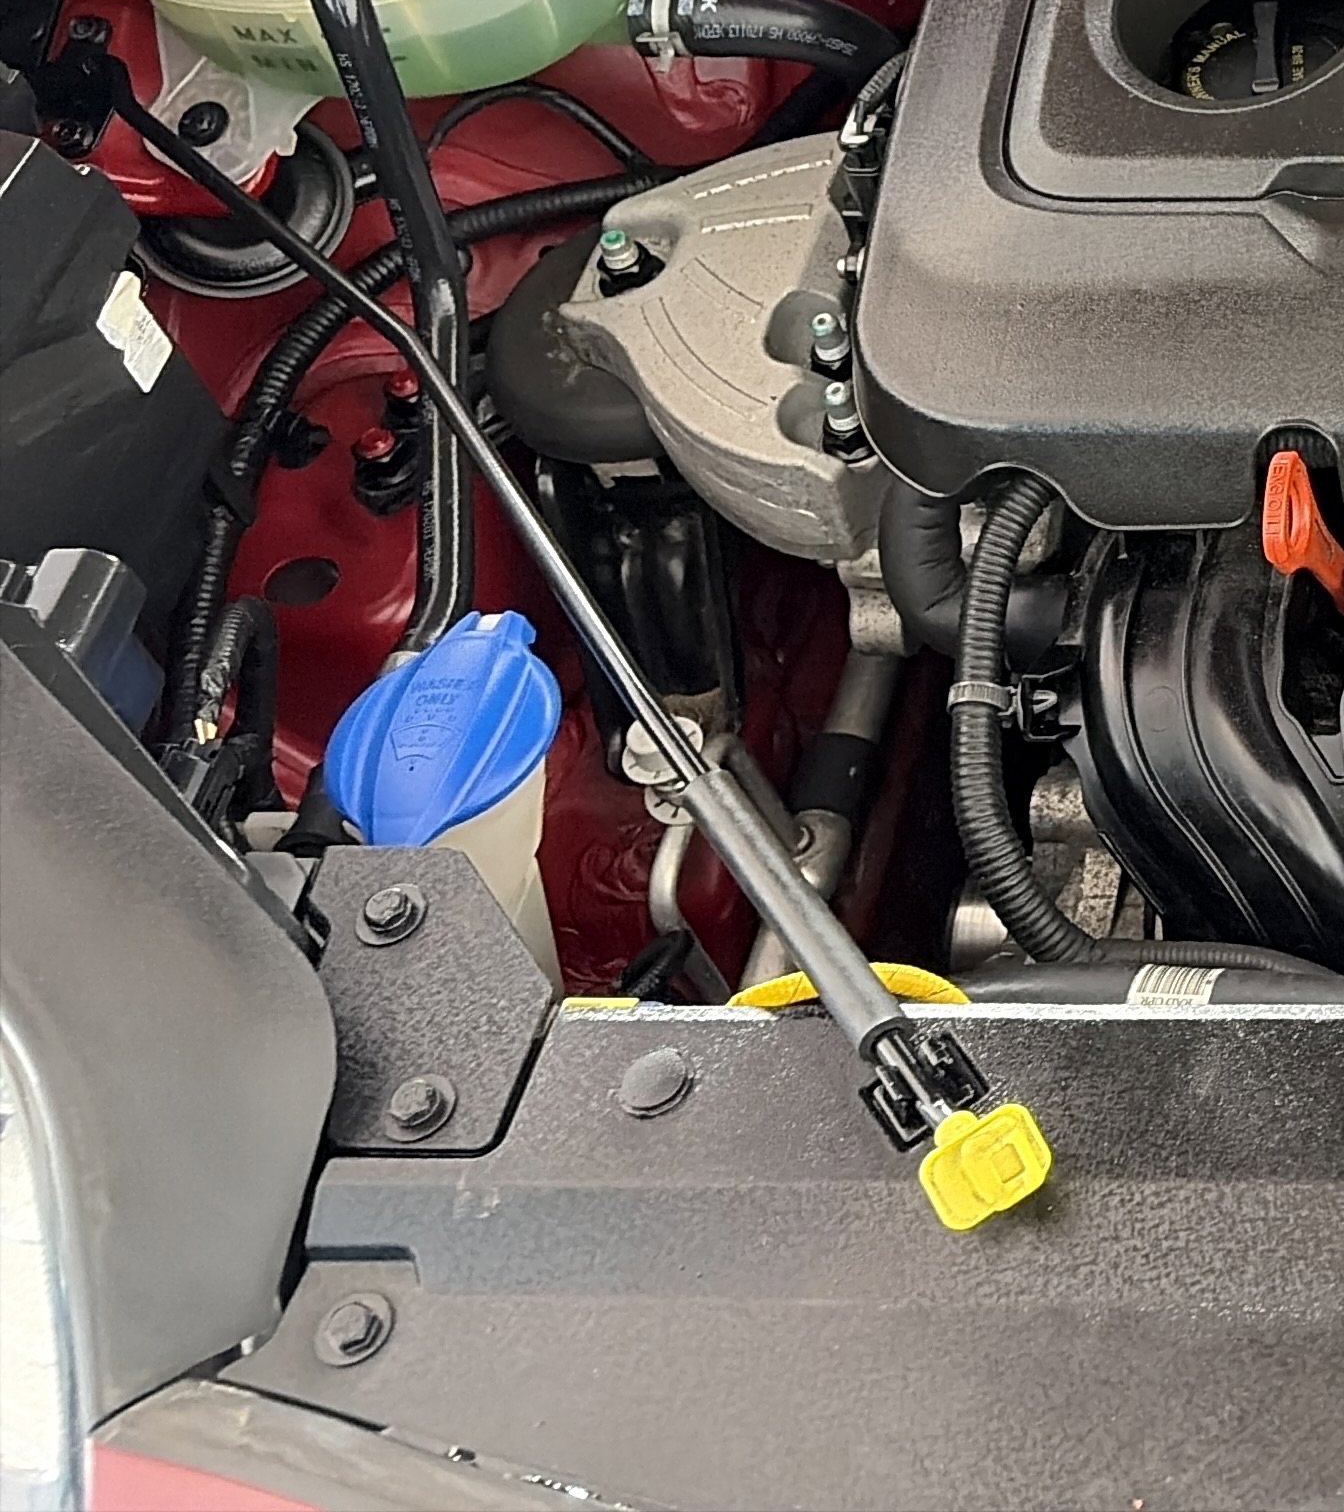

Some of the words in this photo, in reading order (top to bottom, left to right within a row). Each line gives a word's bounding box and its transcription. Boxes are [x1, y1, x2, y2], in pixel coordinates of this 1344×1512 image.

[232, 25, 298, 44] MAX
[1192, 30, 1247, 64] MANUAL
[251, 54, 319, 73] MIN
[1267, 465, 1289, 495] ENG
[1264, 499, 1283, 536] OIL
[415, 693, 458, 707] ONLY
